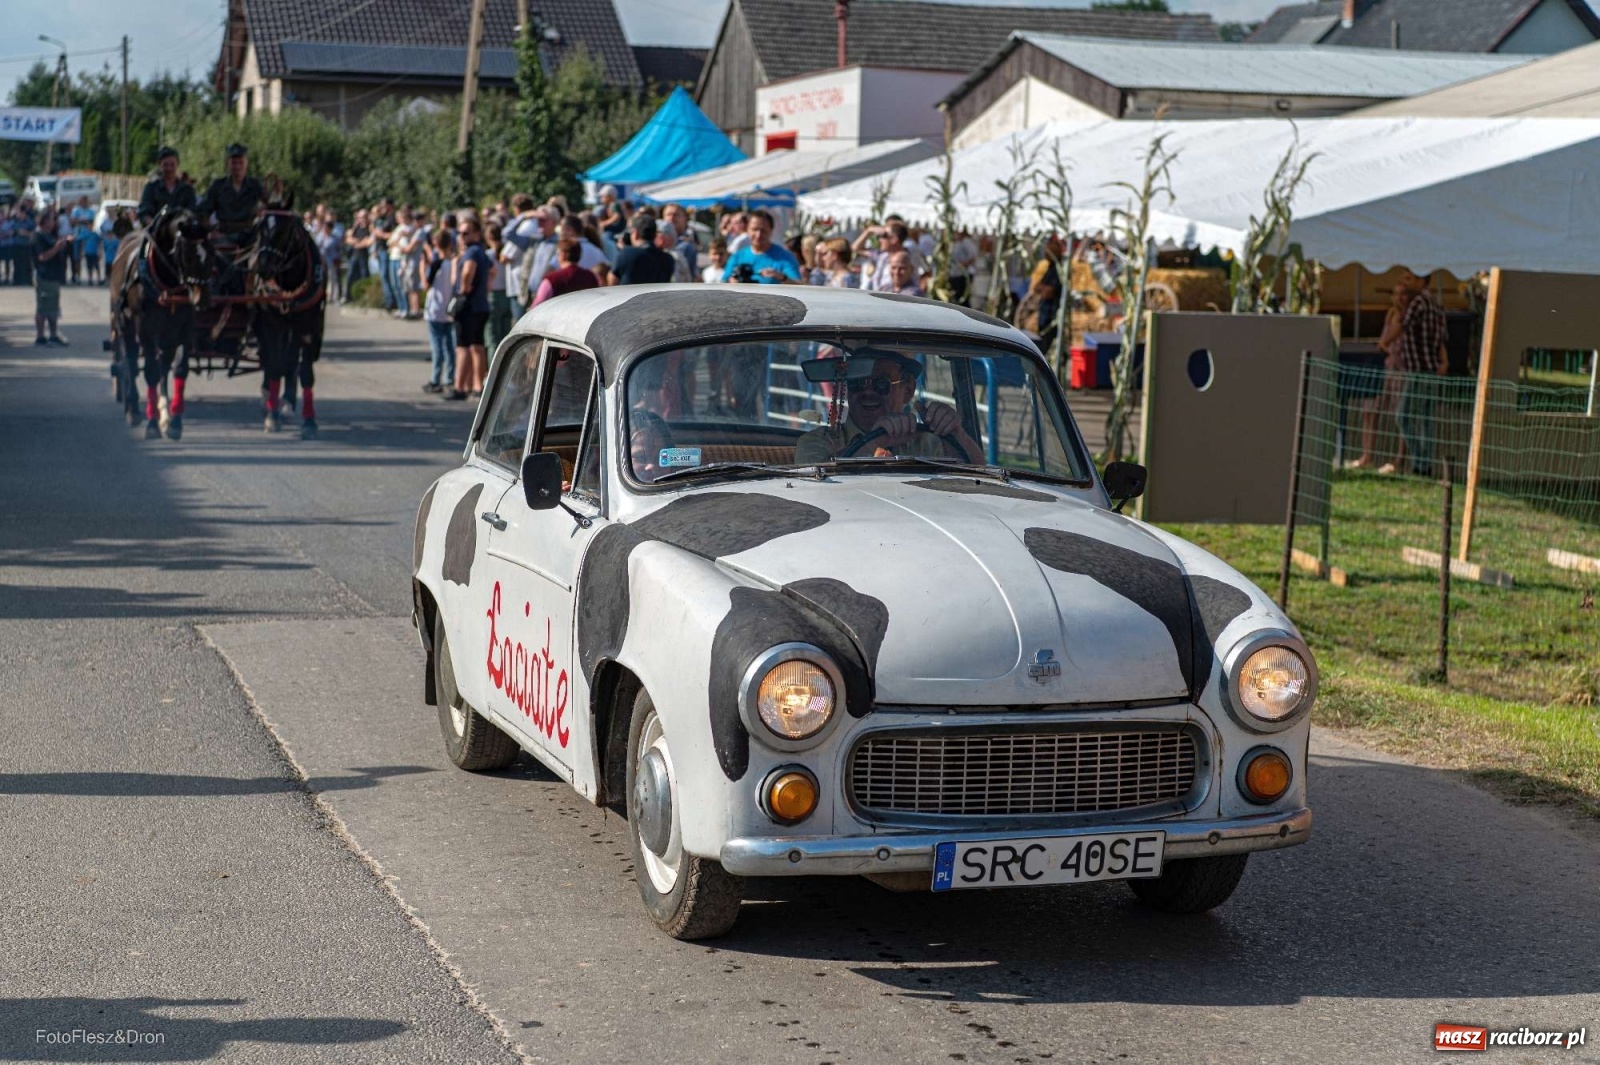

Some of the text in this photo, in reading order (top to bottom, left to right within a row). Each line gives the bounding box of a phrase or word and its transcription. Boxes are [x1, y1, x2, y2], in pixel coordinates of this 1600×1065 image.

[2, 115, 57, 132] START
[960, 836, 1158, 883] SRC 40SE
[936, 871, 951, 882] PL
